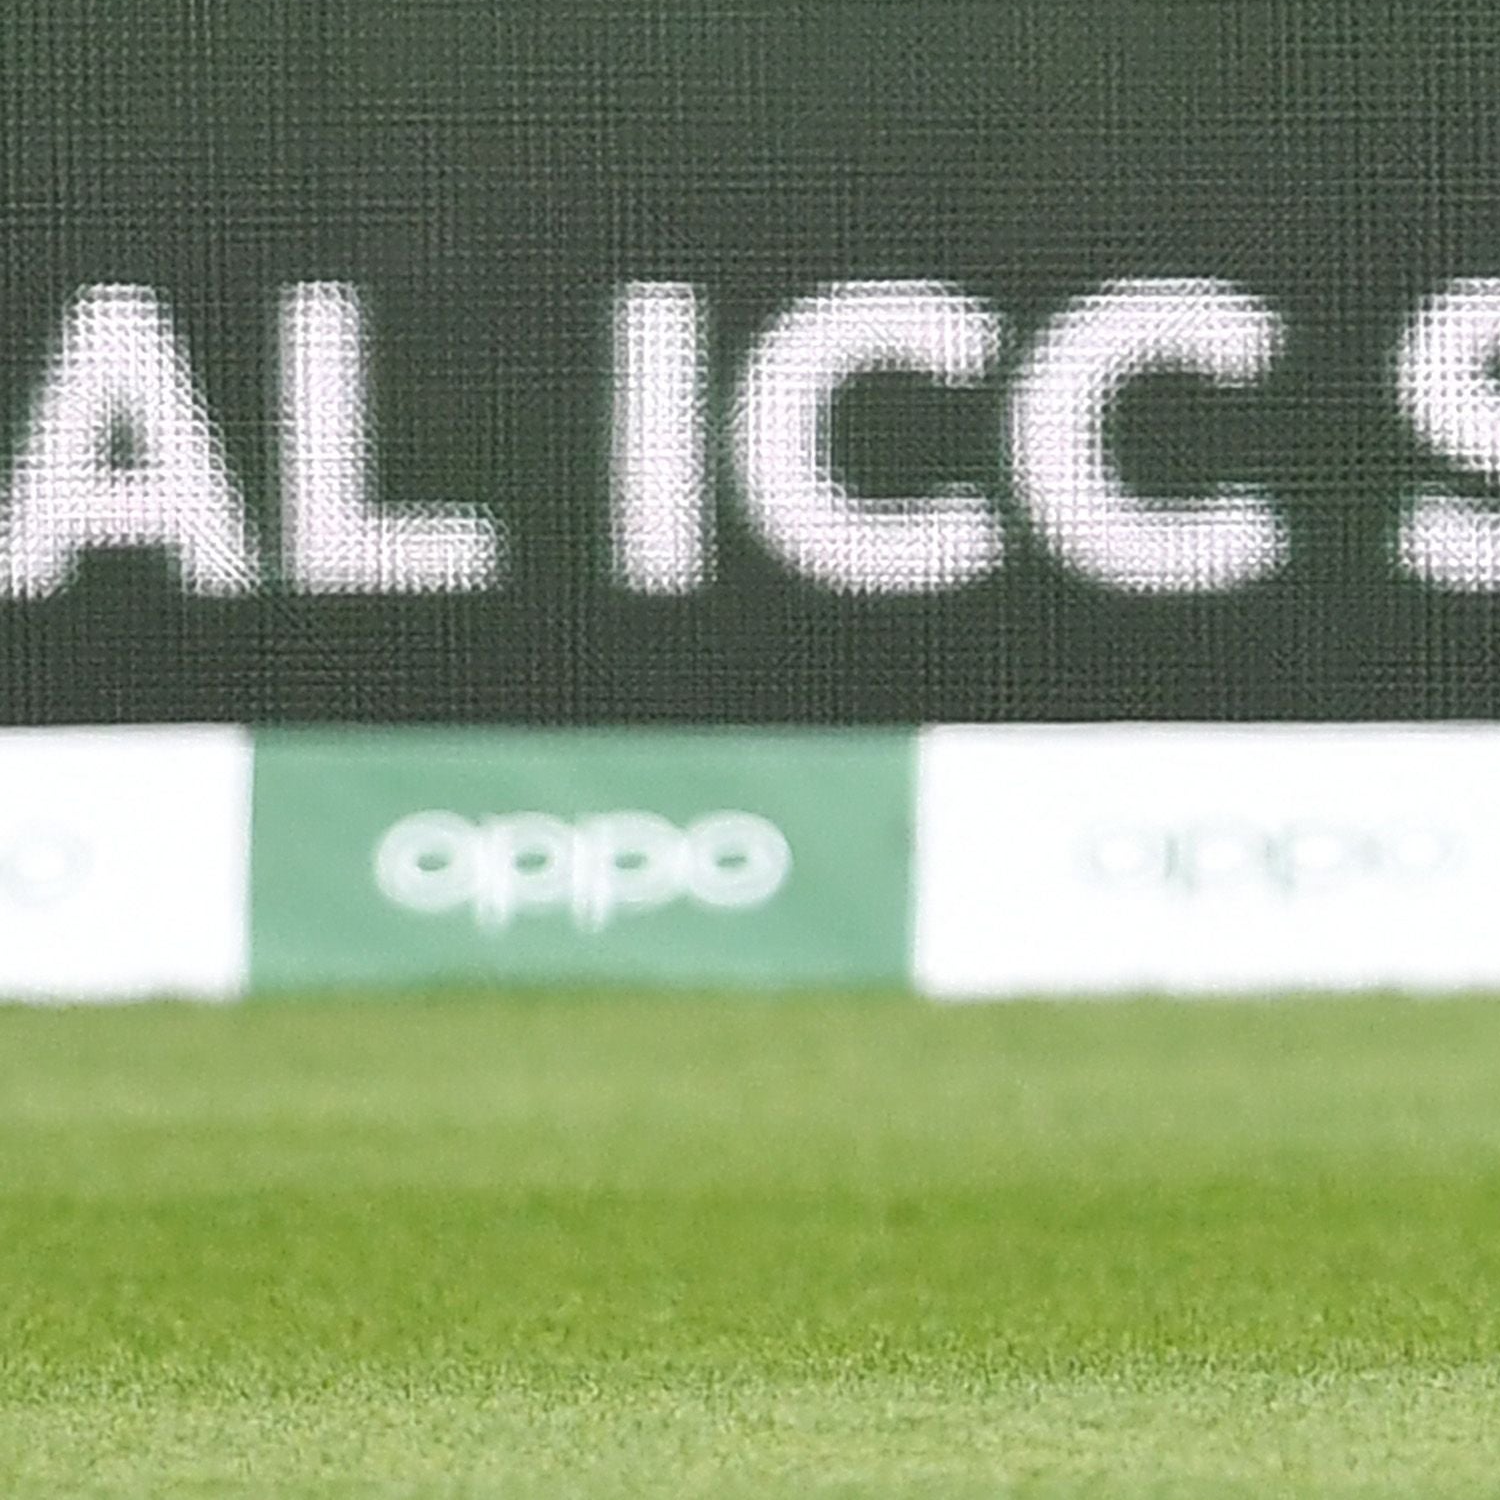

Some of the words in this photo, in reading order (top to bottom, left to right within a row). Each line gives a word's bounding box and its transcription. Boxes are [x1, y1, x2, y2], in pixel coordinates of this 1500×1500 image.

[0, 279, 502, 598] AL
[608, 277, 1290, 595] ICC
[374, 811, 791, 930] oppo
